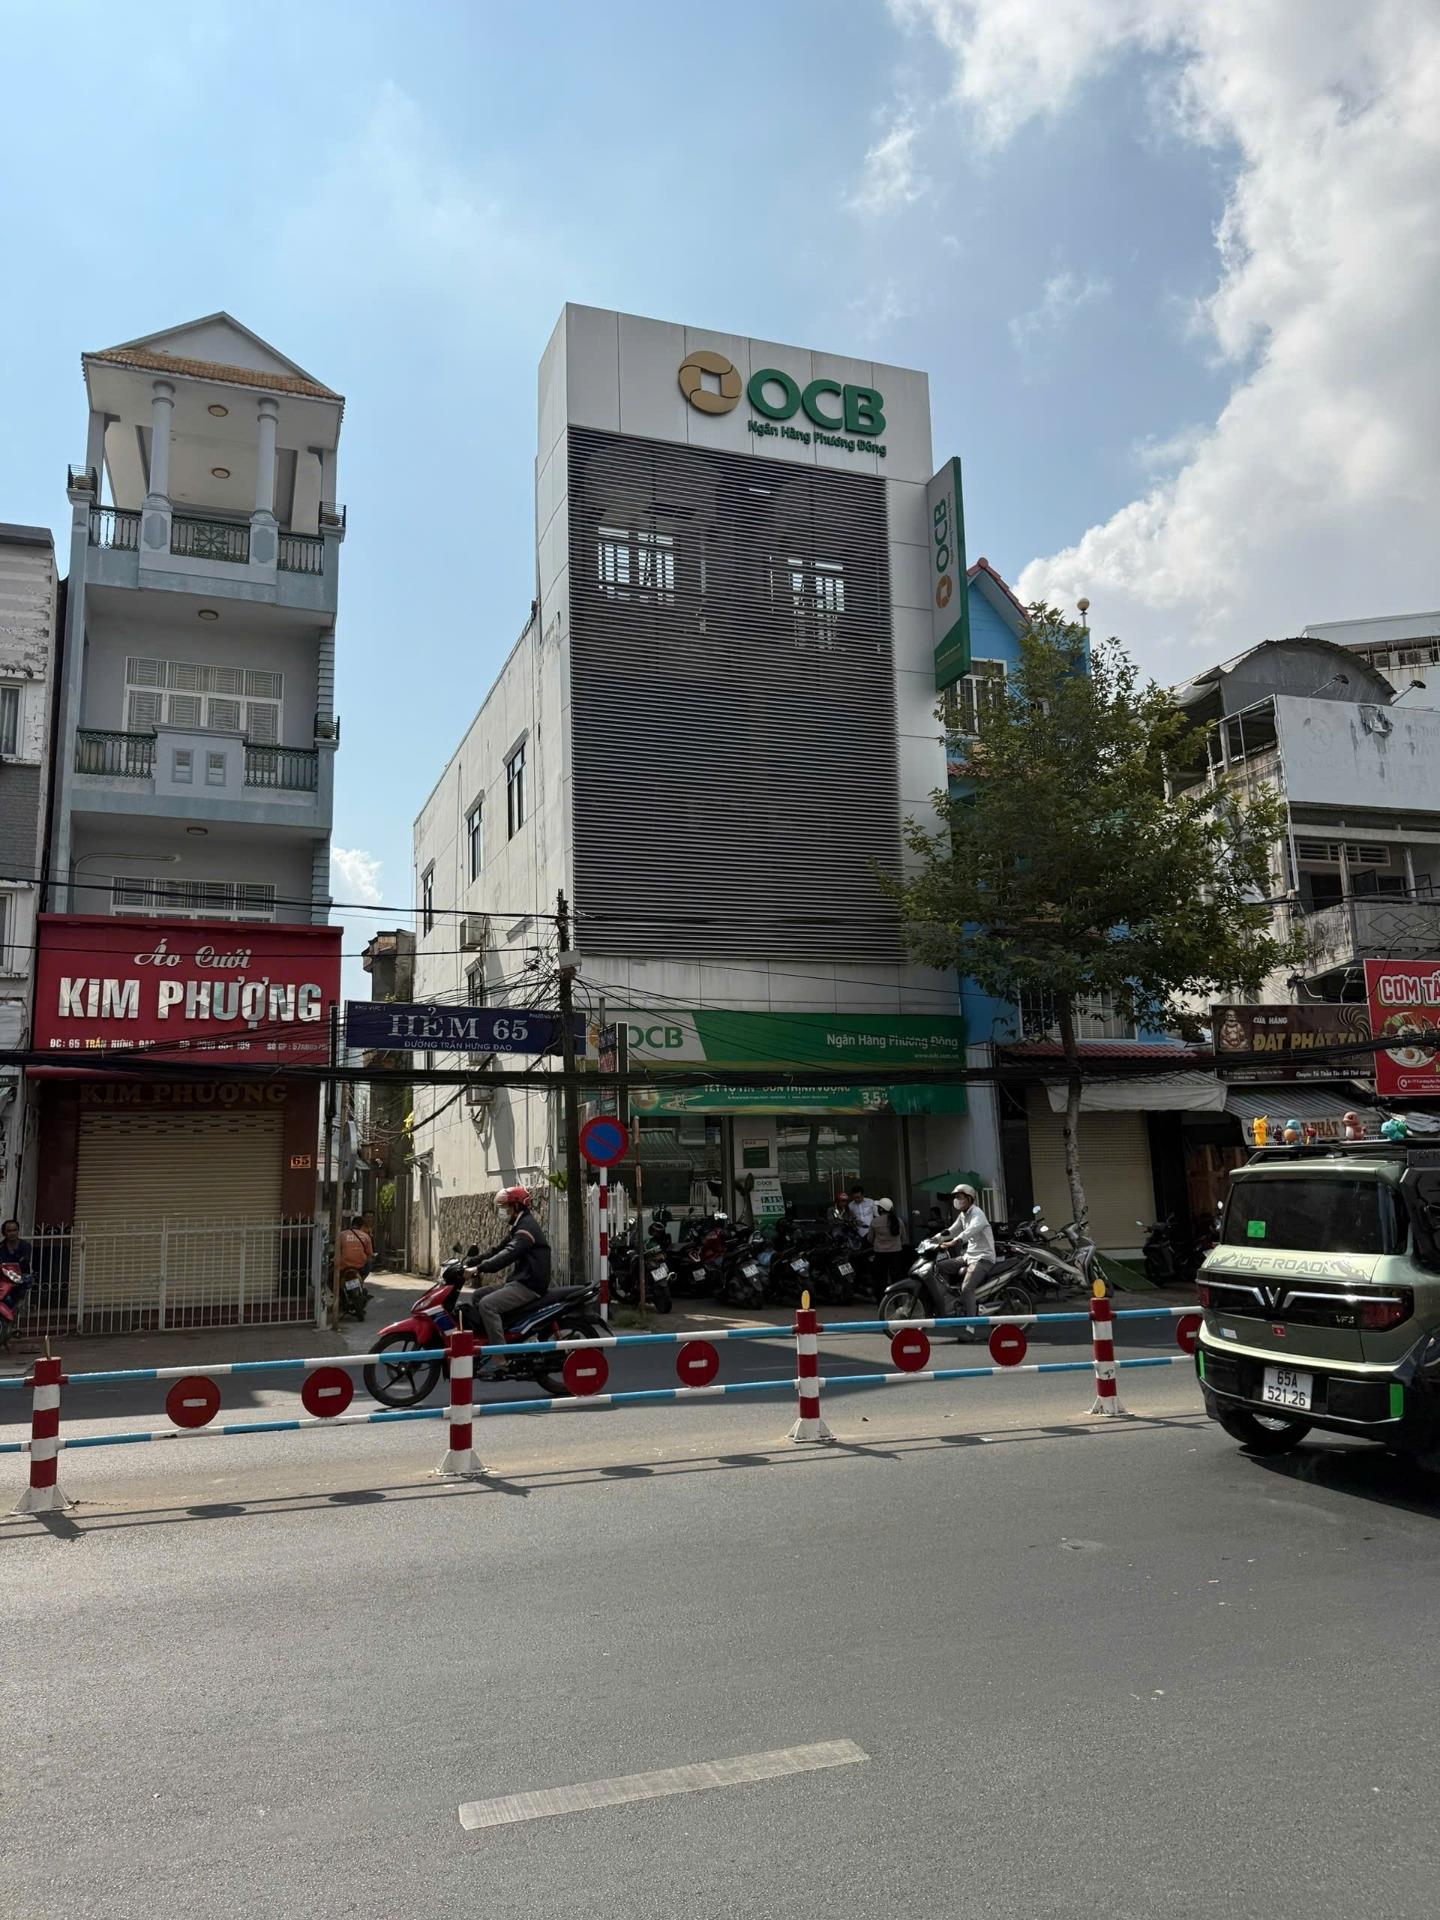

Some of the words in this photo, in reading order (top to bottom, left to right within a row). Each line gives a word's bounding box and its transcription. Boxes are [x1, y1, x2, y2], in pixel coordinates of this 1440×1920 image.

[747, 368, 886, 435] OCB
[748, 420, 778, 437] Ngân
[781, 426, 811, 445] Hàng
[813, 431, 855, 452] Phương
[857, 439, 887, 458] Đông
[934, 498, 949, 573] OCB
[134, 938, 182, 967] Áo
[195, 945, 252, 969] Cưới
[157, 975, 322, 1029] PHƯỢNG
[387, 1006, 480, 1039] HẺM
[492, 1018, 529, 1041] 65
[68, 1038, 80, 1048] 65
[404, 1038, 438, 1048] ĐƯỜNG
[440, 1039, 462, 1049] TRẦN
[465, 1041, 491, 1050] HƯNG
[628, 1025, 684, 1049] OCB
[826, 1033, 855, 1048] Ngân
[858, 1034, 886, 1048] Hàng
[889, 1035, 928, 1049] Phương
[930, 1036, 958, 1050] Đông
[1291, 1027, 1334, 1049] PHÁT
[81, 1083, 141, 1103] KIM
[150, 1080, 288, 1107] PHƯỢNG
[862, 1091, 881, 1105] 3.5
[292, 1155, 309, 1166] 65
[1241, 1255, 1273, 1268] OFF
[1272, 1259, 1323, 1273] ROAD
[1277, 1370, 1298, 1388] 65A
[1267, 1385, 1306, 1407] 521.26
